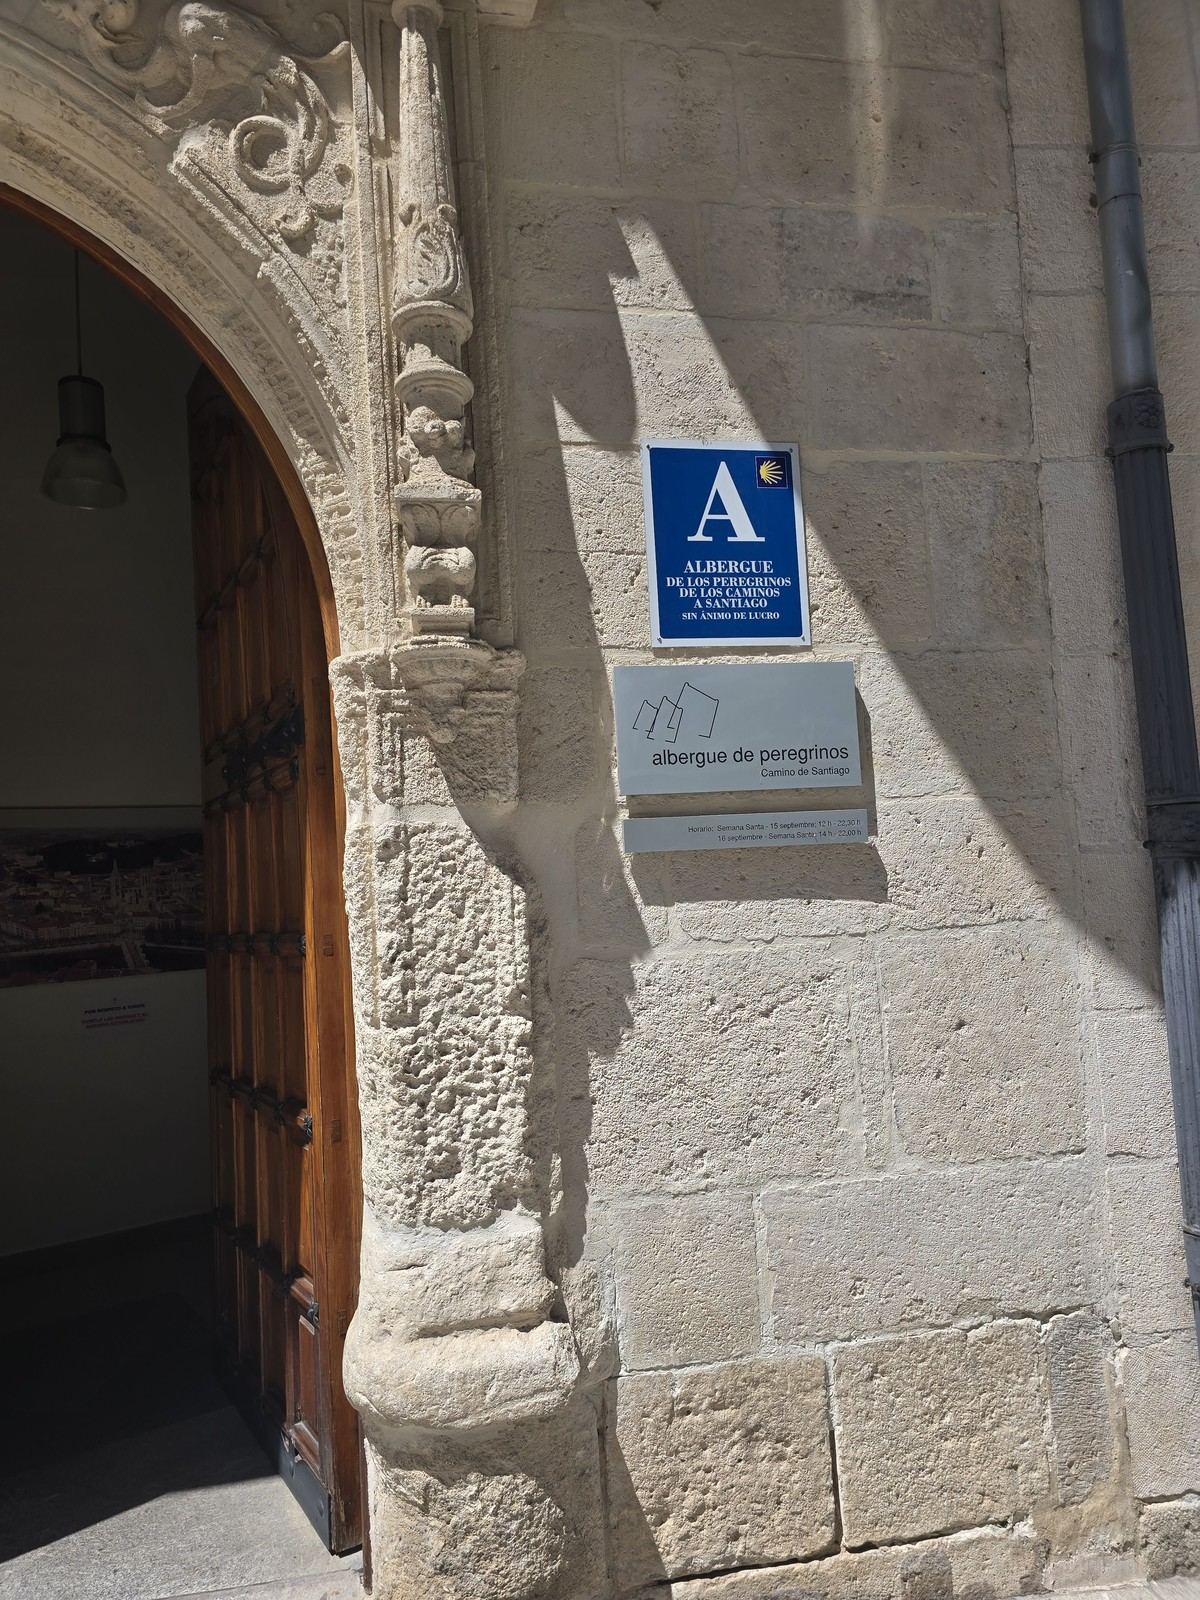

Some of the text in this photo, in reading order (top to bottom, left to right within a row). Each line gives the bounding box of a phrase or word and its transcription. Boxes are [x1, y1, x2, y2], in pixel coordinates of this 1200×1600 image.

[687, 461, 766, 542] A
[683, 560, 774, 574] ALBERGUE
[666, 576, 792, 587] DE LOS PEREGRINOS
[679, 587, 780, 598] DE LOS CAMINOS
[694, 598, 768, 608] A SANTIAGO
[682, 611, 780, 620] SIN ÁNIMO DE LUCRO
[652, 745, 849, 768] albergue de peregrinos
[761, 766, 850, 777] Camino de Santiago
[745, 823, 764, 831] Santa
[727, 834, 763, 843] septiembre
[768, 832, 795, 840] Semana
